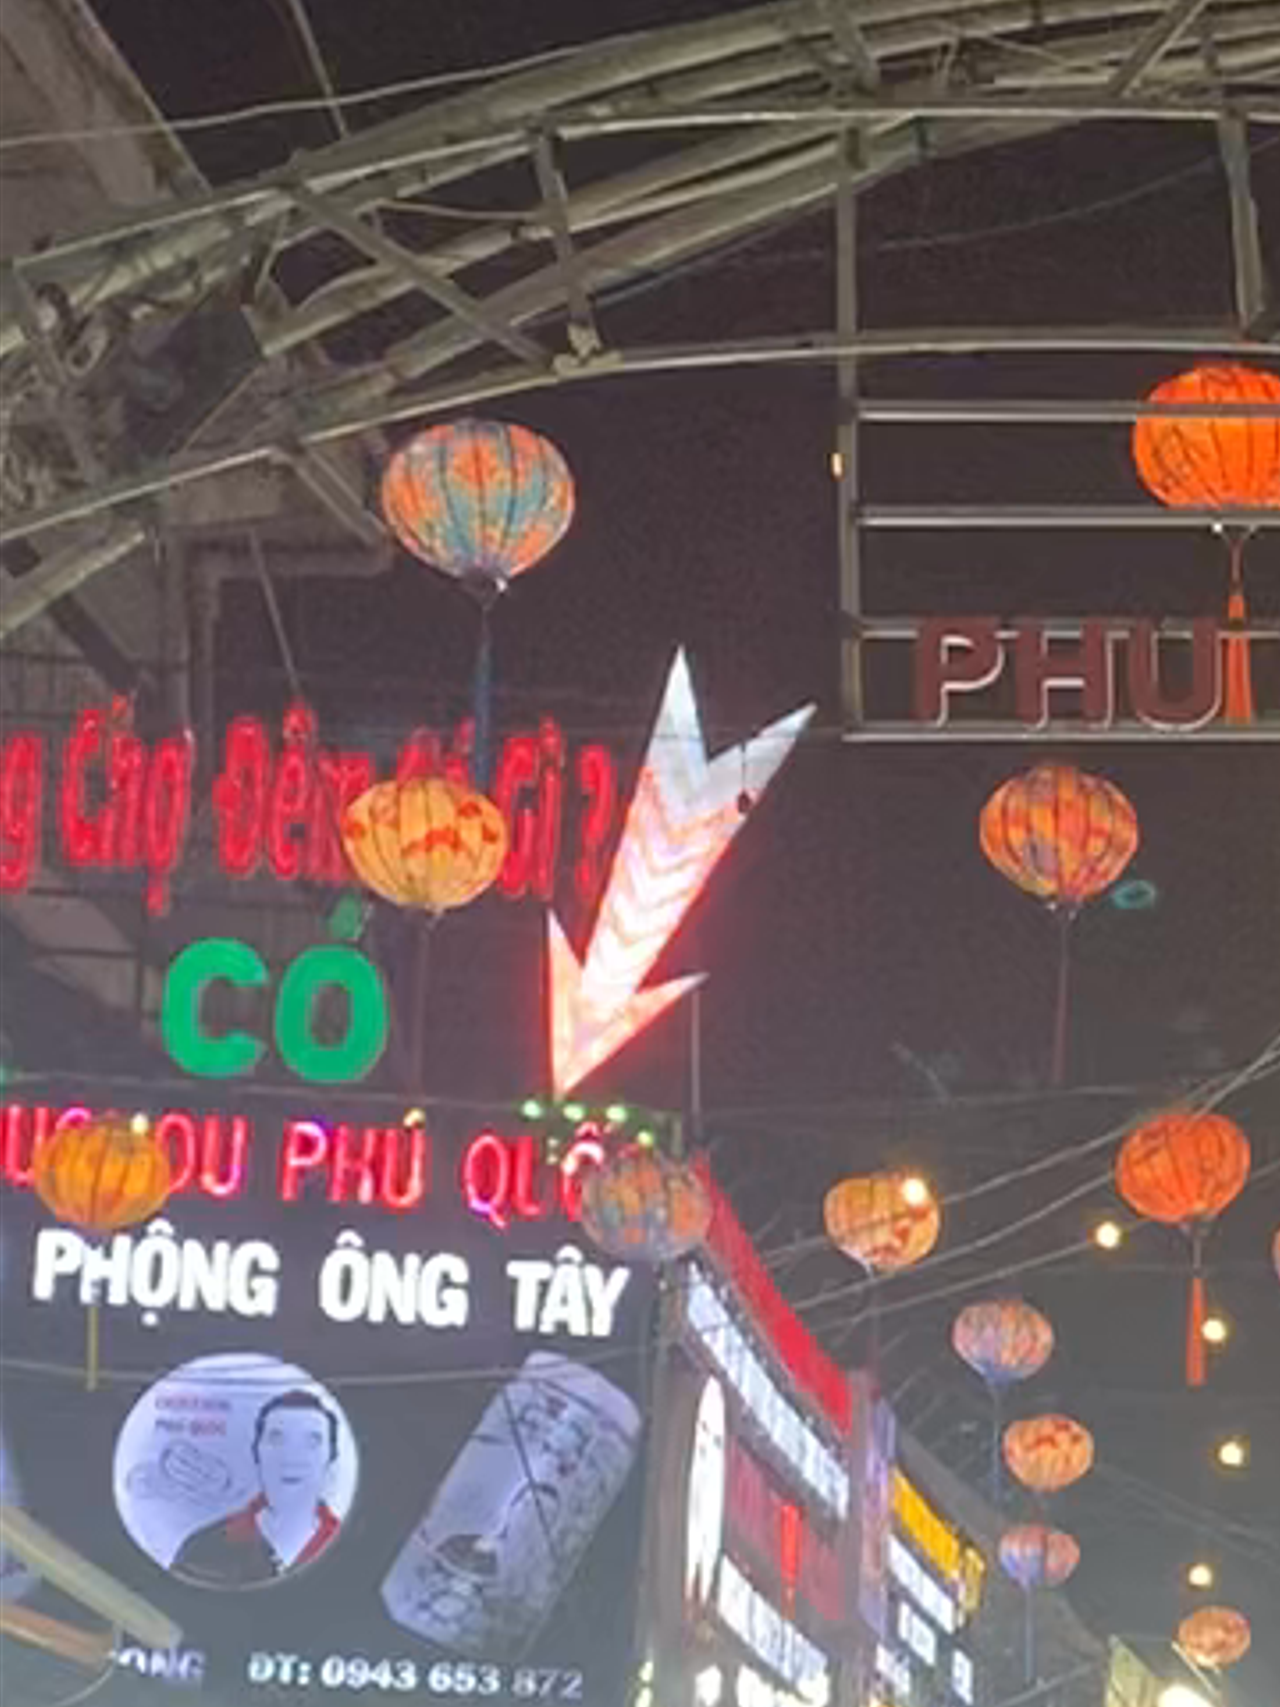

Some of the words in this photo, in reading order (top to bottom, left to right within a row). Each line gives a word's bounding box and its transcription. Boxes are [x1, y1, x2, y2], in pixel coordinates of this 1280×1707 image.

[910, 616, 1223, 730] PHU
[33, 1218, 280, 1326] PHỘNG
[319, 1230, 470, 1326] ÔNG
[506, 1246, 631, 1337] TÂY
[321, 1653, 418, 1692] 0943
[428, 1660, 501, 1695] 653
[510, 1666, 584, 1700] 872
